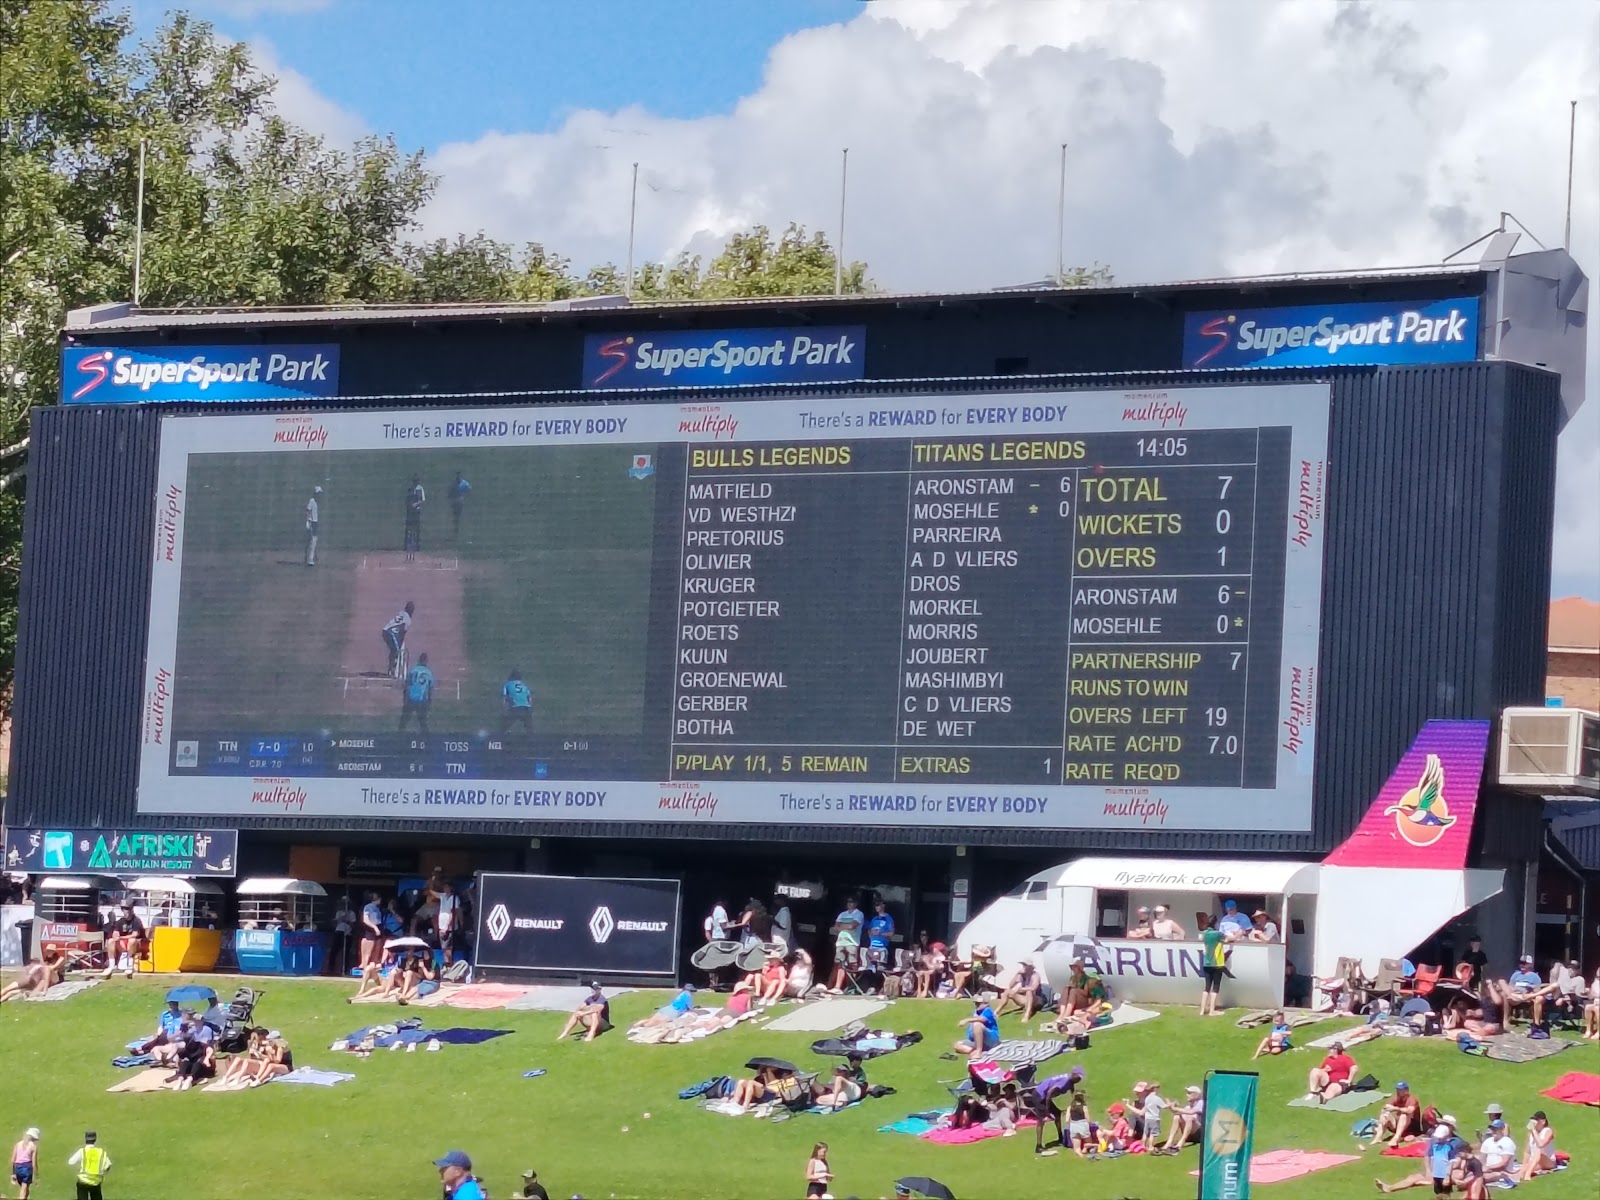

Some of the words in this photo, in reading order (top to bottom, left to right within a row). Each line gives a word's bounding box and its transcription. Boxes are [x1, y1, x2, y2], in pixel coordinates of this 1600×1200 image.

[1238, 317, 1392, 354] SuperSport
[1397, 310, 1467, 343] Park
[635, 339, 785, 376] SuperSport
[789, 335, 855, 365] Park
[113, 356, 261, 390] SuperSport
[265, 353, 330, 382] Park
[799, 412, 851, 428] There's
[855, 415, 864, 427] a
[868, 409, 937, 427] REWARD
[942, 408, 962, 425] for
[966, 407, 1018, 425] EVERY
[1022, 405, 1068, 423] BODY
[1122, 401, 1188, 428] multiply
[383, 422, 430, 439] There's
[434, 426, 442, 438] a
[446, 421, 508, 438] REWARD
[512, 420, 531, 436] for
[535, 419, 582, 436] EVERY
[586, 417, 628, 434] BODY
[679, 414, 738, 439] multiply
[274, 425, 328, 449] multiply
[692, 448, 754, 468] BULLS
[760, 446, 851, 466] LEGENDS
[914, 443, 984, 462] TITANS
[990, 441, 1086, 461] LEGENDS
[1137, 438, 1187, 458] 14:05
[689, 483, 772, 500] MATFIELD
[915, 478, 1014, 495] ARONSTAM
[1060, 476, 1071, 493] 6
[1080, 477, 1167, 502] TOTAL
[1218, 476, 1233, 500] 7
[914, 503, 999, 520] MOSEHLE
[1059, 501, 1069, 517] 0
[1292, 460, 1314, 547] multiply
[166, 485, 182, 561] multiply
[689, 507, 711, 523] VD
[1079, 513, 1182, 535] WICKETS
[1216, 509, 1230, 534] 0
[687, 529, 784, 547] PRETORIUS
[913, 527, 1002, 543] PARREIRA
[685, 554, 751, 570] OLIVIER
[910, 552, 923, 567] A
[933, 552, 945, 567] D
[955, 551, 1018, 567] VLIERS
[1077, 547, 1156, 568] OVERS
[1217, 546, 1226, 567] 1
[684, 577, 755, 594] KRUGER
[910, 575, 961, 592] DROS
[1074, 588, 1177, 605] ARONSTAM
[1218, 585, 1230, 604] 6
[683, 601, 780, 617] POTGIETER
[909, 600, 982, 616] MORKEL
[682, 625, 739, 641] ROETS
[908, 623, 978, 640] MORRIS
[1073, 617, 1162, 634] MOSEHLE
[1216, 615, 1228, 634] 0
[680, 648, 728, 664] KUUN
[906, 648, 988, 664] JOUBERT
[1072, 652, 1201, 669] PARTNERSHIP
[1230, 652, 1242, 670] 7
[680, 672, 787, 688] GROENEWAL
[905, 672, 1003, 688] MASHIMBYI
[1071, 680, 1121, 696] RUNS
[1124, 680, 1150, 696] TO
[1153, 680, 1188, 696] WIN
[153, 667, 171, 744] multiply
[678, 696, 748, 712] GERBER
[904, 696, 917, 712] C
[927, 696, 939, 712] D
[949, 696, 1012, 713] VLIERS
[1283, 667, 1305, 754] multiply
[1069, 707, 1132, 724] OVERS
[1142, 707, 1188, 724] LEFT
[1205, 707, 1227, 726] 19
[677, 719, 734, 735] BOTHA
[903, 721, 927, 736] DE
[937, 721, 976, 736] WET
[219, 741, 238, 751] TTN
[444, 741, 469, 751] TOSS
[1068, 736, 1116, 752] RATE
[1125, 736, 1182, 752] ACH'D
[1208, 736, 1238, 754] 7.0
[446, 764, 466, 774] TTN
[676, 755, 734, 771] P/PLAY
[744, 756, 772, 774] 1/1,
[782, 756, 792, 771] 5
[801, 756, 868, 772] REMAIN
[901, 757, 971, 773] EXTRAS
[1043, 758, 1051, 774] 1
[1066, 763, 1113, 779] RATE
[1124, 763, 1180, 781] REQ'D
[252, 786, 307, 811] multiply
[361, 788, 409, 805] There's
[413, 792, 421, 805] a
[424, 789, 487, 805] REWARD
[491, 789, 510, 805] for
[514, 790, 561, 806] EVERY
[565, 791, 607, 807] BODY
[658, 792, 718, 817] multiply
[780, 794, 831, 810] There's
[836, 799, 844, 810] a
[849, 795, 917, 811] REWARD
[921, 795, 943, 811] for
[947, 796, 998, 812] EVERY
[1002, 797, 1048, 813] BODY
[1103, 798, 1168, 824] multiply
[116, 834, 194, 857] AFRISKI
[115, 860, 160, 869] MOUNTAIN
[1114, 872, 1232, 886] flyairlink.com
[514, 918, 564, 930] RENAULT
[617, 921, 668, 932] RENAULT
